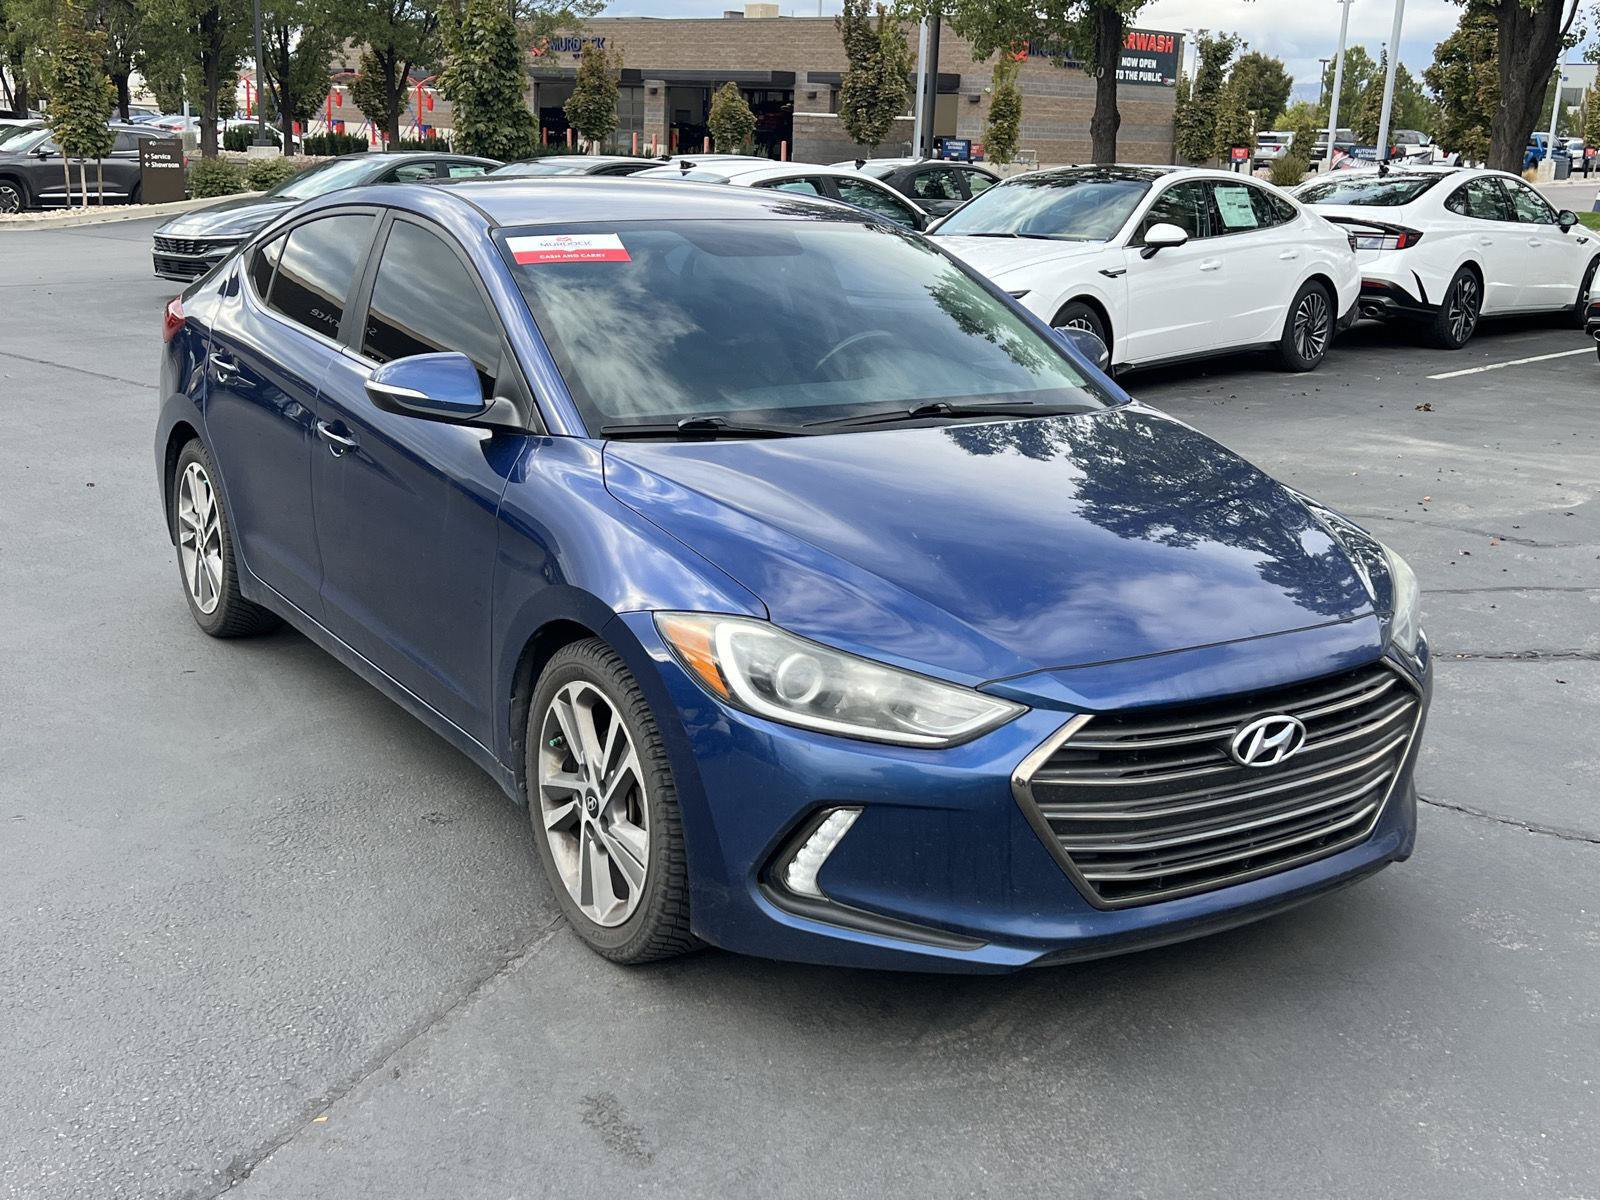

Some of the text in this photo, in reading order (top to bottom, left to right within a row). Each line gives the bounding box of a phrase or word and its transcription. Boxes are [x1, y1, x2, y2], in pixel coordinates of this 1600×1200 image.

[1121, 57, 1157, 69] NOW OPEN
[1115, 69, 1124, 80] TO
[1125, 70, 1138, 80] THE
[1138, 71, 1162, 82] PUBLIC
